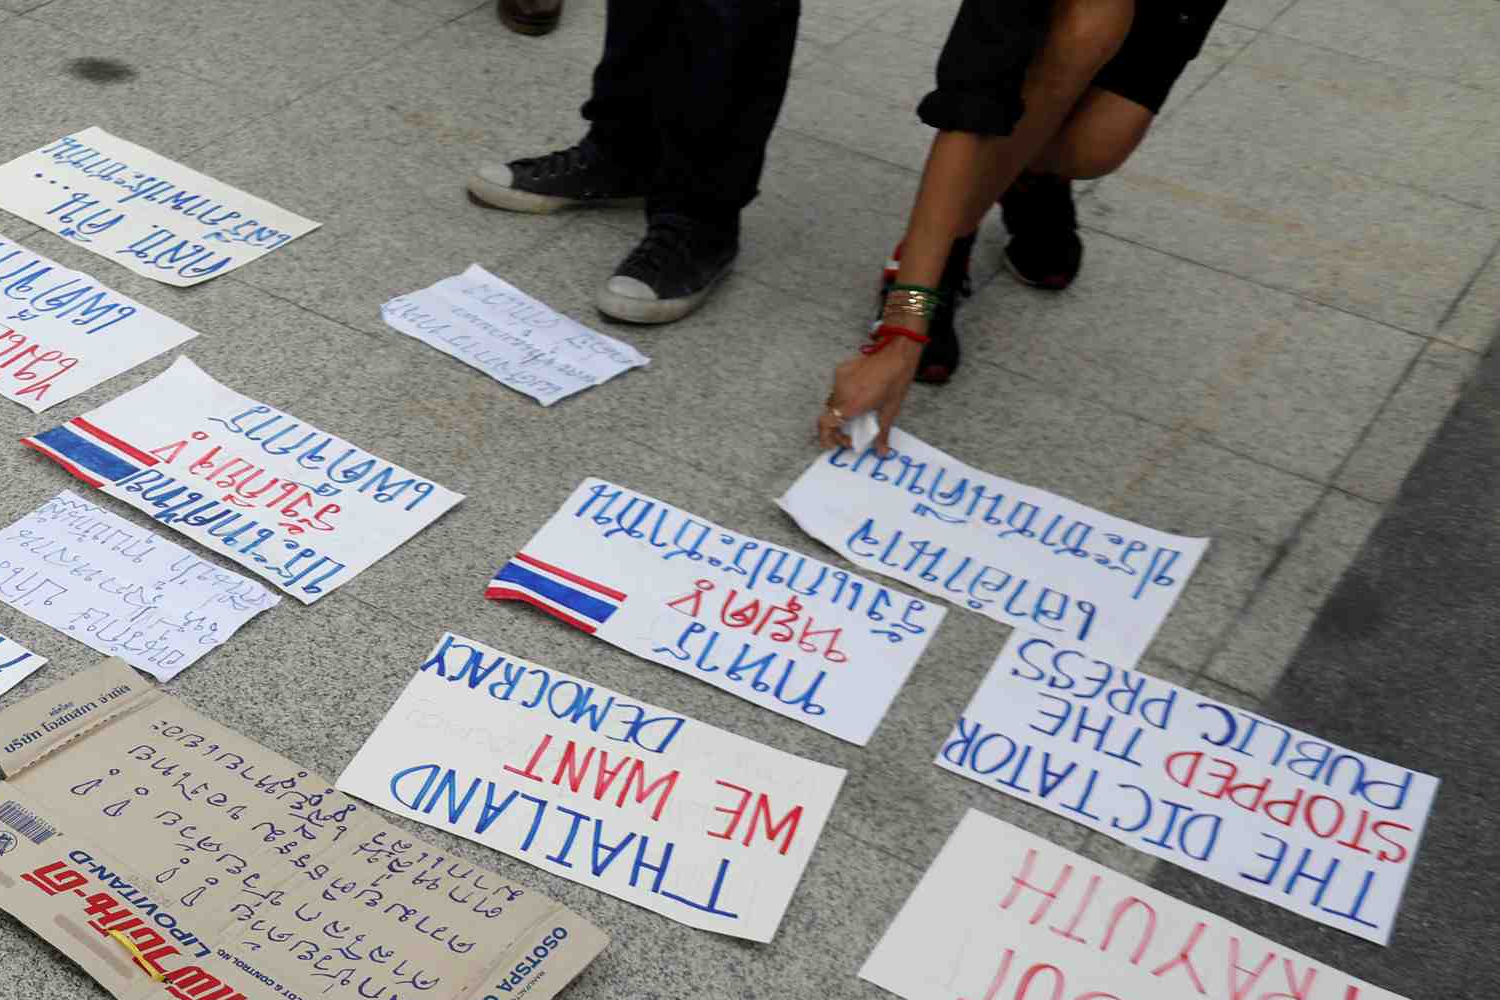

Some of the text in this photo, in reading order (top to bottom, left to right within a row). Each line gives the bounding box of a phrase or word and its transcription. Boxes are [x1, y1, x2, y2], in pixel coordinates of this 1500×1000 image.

[41, 137, 292, 249] เสรีภาพประชาชน
[116, 225, 233, 278] คสช.
[207, 392, 444, 511] เผด็จการ
[115, 464, 346, 594] ประเทศไทย
[574, 484, 926, 643] รังแกประชาชน
[846, 518, 1098, 642] เอาอำนาจ
[416, 636, 686, 754] DEMOCRACY
[652, 622, 828, 716] ทหาร
[1010, 638, 1420, 811] PUBLIC PRESS
[503, 734, 804, 856] WE WANT
[941, 715, 1379, 929] THE DICTATOR
[1028, 692, 1413, 864] STOPPED THE
[390, 764, 739, 919] THAILAND
[69, 850, 212, 958] LIPOVITAN-D
[495, 927, 568, 992] OSOTSPA
[232, 957, 276, 987] CONTROL
